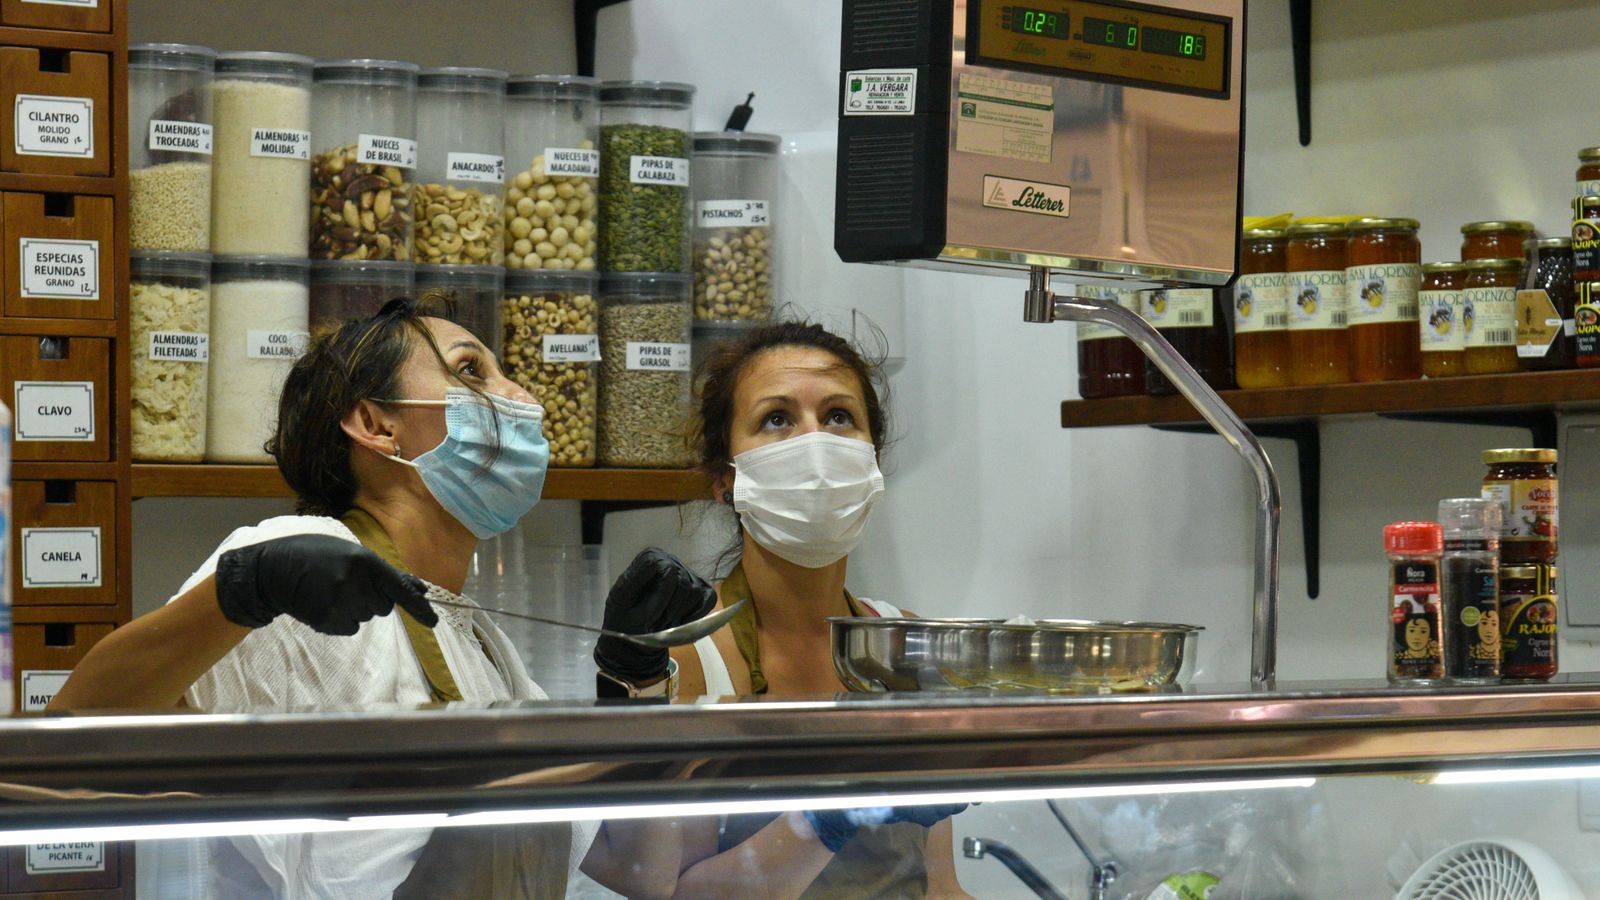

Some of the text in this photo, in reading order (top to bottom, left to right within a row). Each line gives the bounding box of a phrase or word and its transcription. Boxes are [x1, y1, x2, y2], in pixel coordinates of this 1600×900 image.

[1127, 27, 1136, 46] 0
[866, 83, 908, 92] J.A. VERGARA
[28, 111, 80, 123] CILANTRO
[38, 125, 71, 134] MOLIDO
[154, 123, 200, 136] ALMENDRAS
[40, 135, 69, 144] GRANO
[156, 136, 199, 148] TROCEADAS
[255, 131, 299, 143] ALMENDRAS
[261, 143, 295, 154] MOLIDAS
[372, 138, 400, 151] NUECES
[366, 150, 377, 160] DE
[378, 151, 402, 163] BRASIL
[553, 151, 581, 161] NUECES
[451, 161, 494, 174] ANACARDOS
[641, 159, 663, 169] PIPAS
[665, 160, 674, 169] DE
[637, 170, 675, 181] CALABAZA
[1012, 186, 1064, 213] Letterer
[702, 209, 743, 219] PISTACHOS
[36, 252, 84, 264] ESPECIAS
[34, 265, 86, 277] REUNIDAS
[45, 278, 75, 288] GRANO
[1304, 271, 1346, 287] LOREN
[1437, 292, 1463, 307] LOR
[153, 334, 198, 346] ALMENDRAS
[268, 334, 288, 344] COCO
[154, 346, 197, 358] FILETEADAS
[549, 343, 588, 353] AVELLANAS
[639, 346, 672, 356] PIPAS DE
[640, 357, 671, 367] GIRASOL
[37, 406, 72, 416] CLAVO
[41, 551, 82, 562] CANELA
[29, 694, 54, 705] MAT
[48, 852, 83, 861] PICANTE
